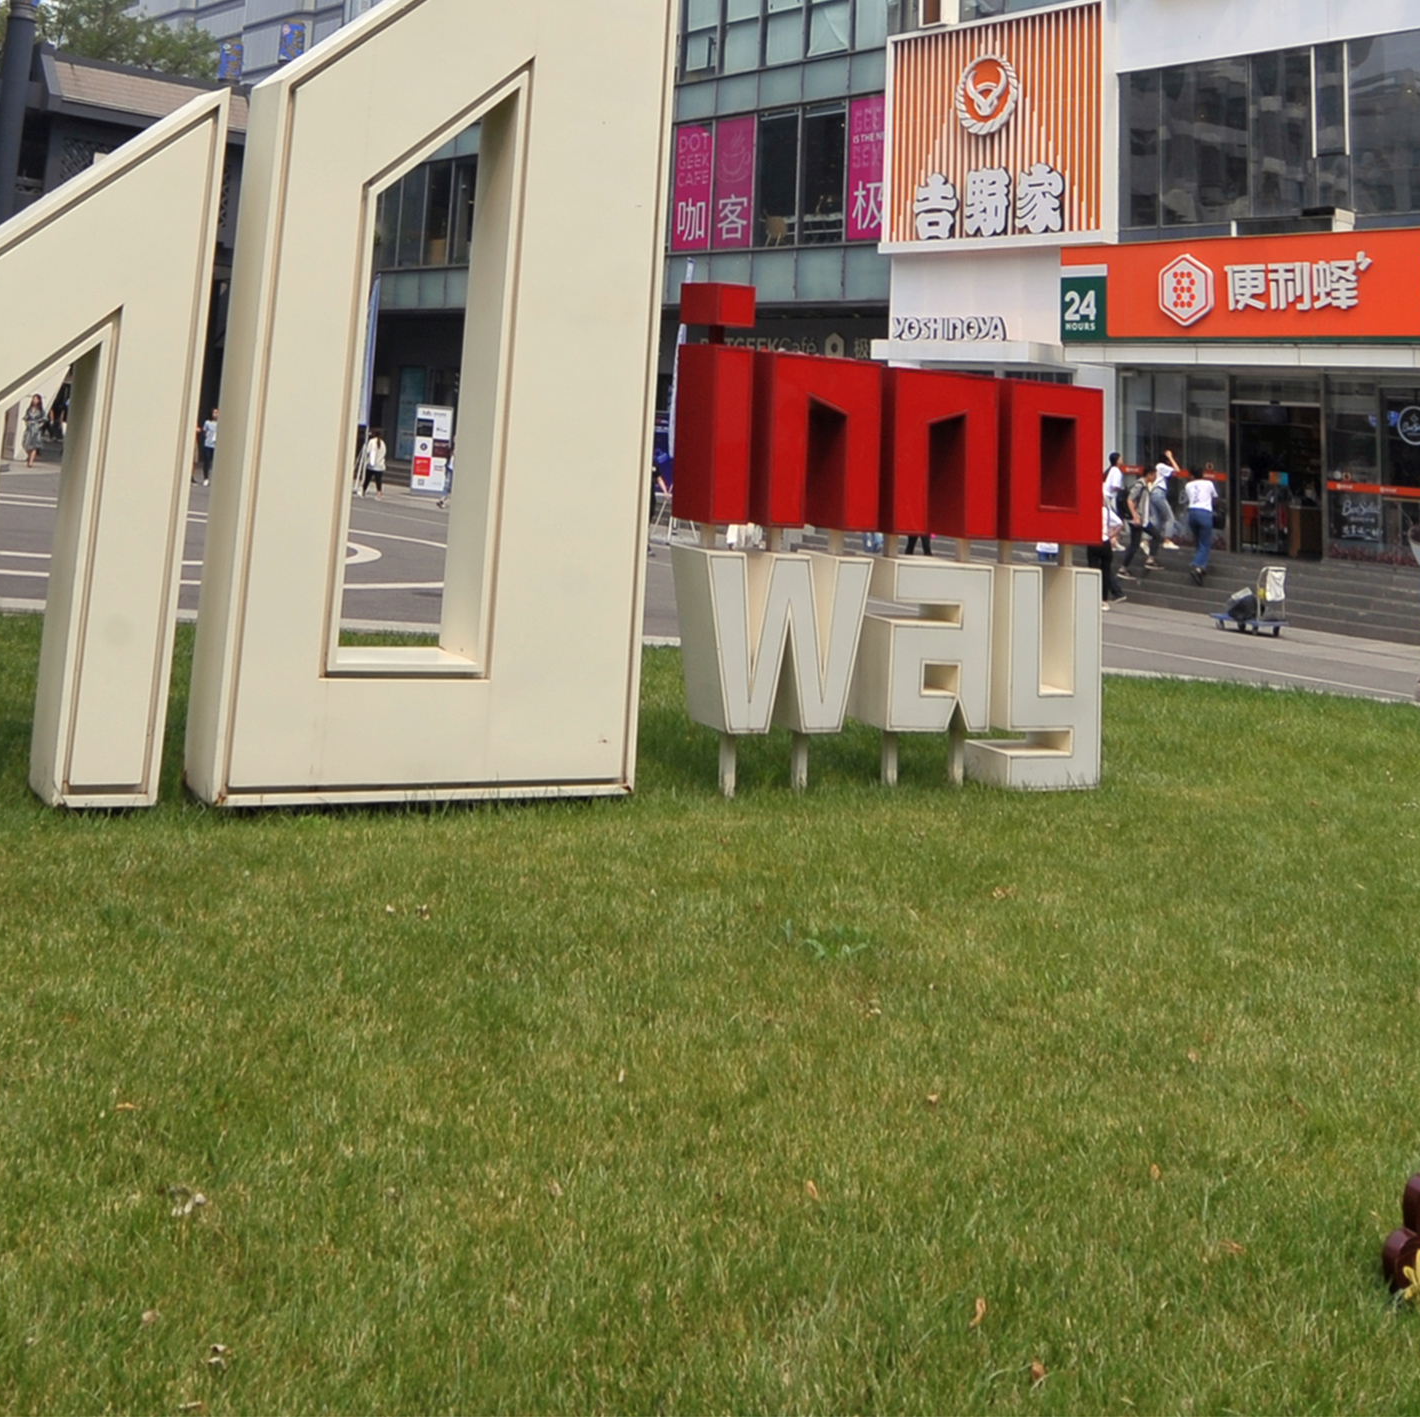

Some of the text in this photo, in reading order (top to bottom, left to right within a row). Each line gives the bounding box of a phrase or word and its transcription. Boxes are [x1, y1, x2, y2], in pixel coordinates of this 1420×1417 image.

[679, 132, 710, 155] DOT
[678, 152, 711, 170] GEEK
[677, 170, 710, 188] CAFE
[913, 162, 1065, 241] 吉野家
[1223, 250, 1373, 313] 便利蜂
[1063, 289, 1097, 322] 24
[891, 315, 1008, 342] YOSHINOYA
[1065, 322, 1097, 332] HOURS
